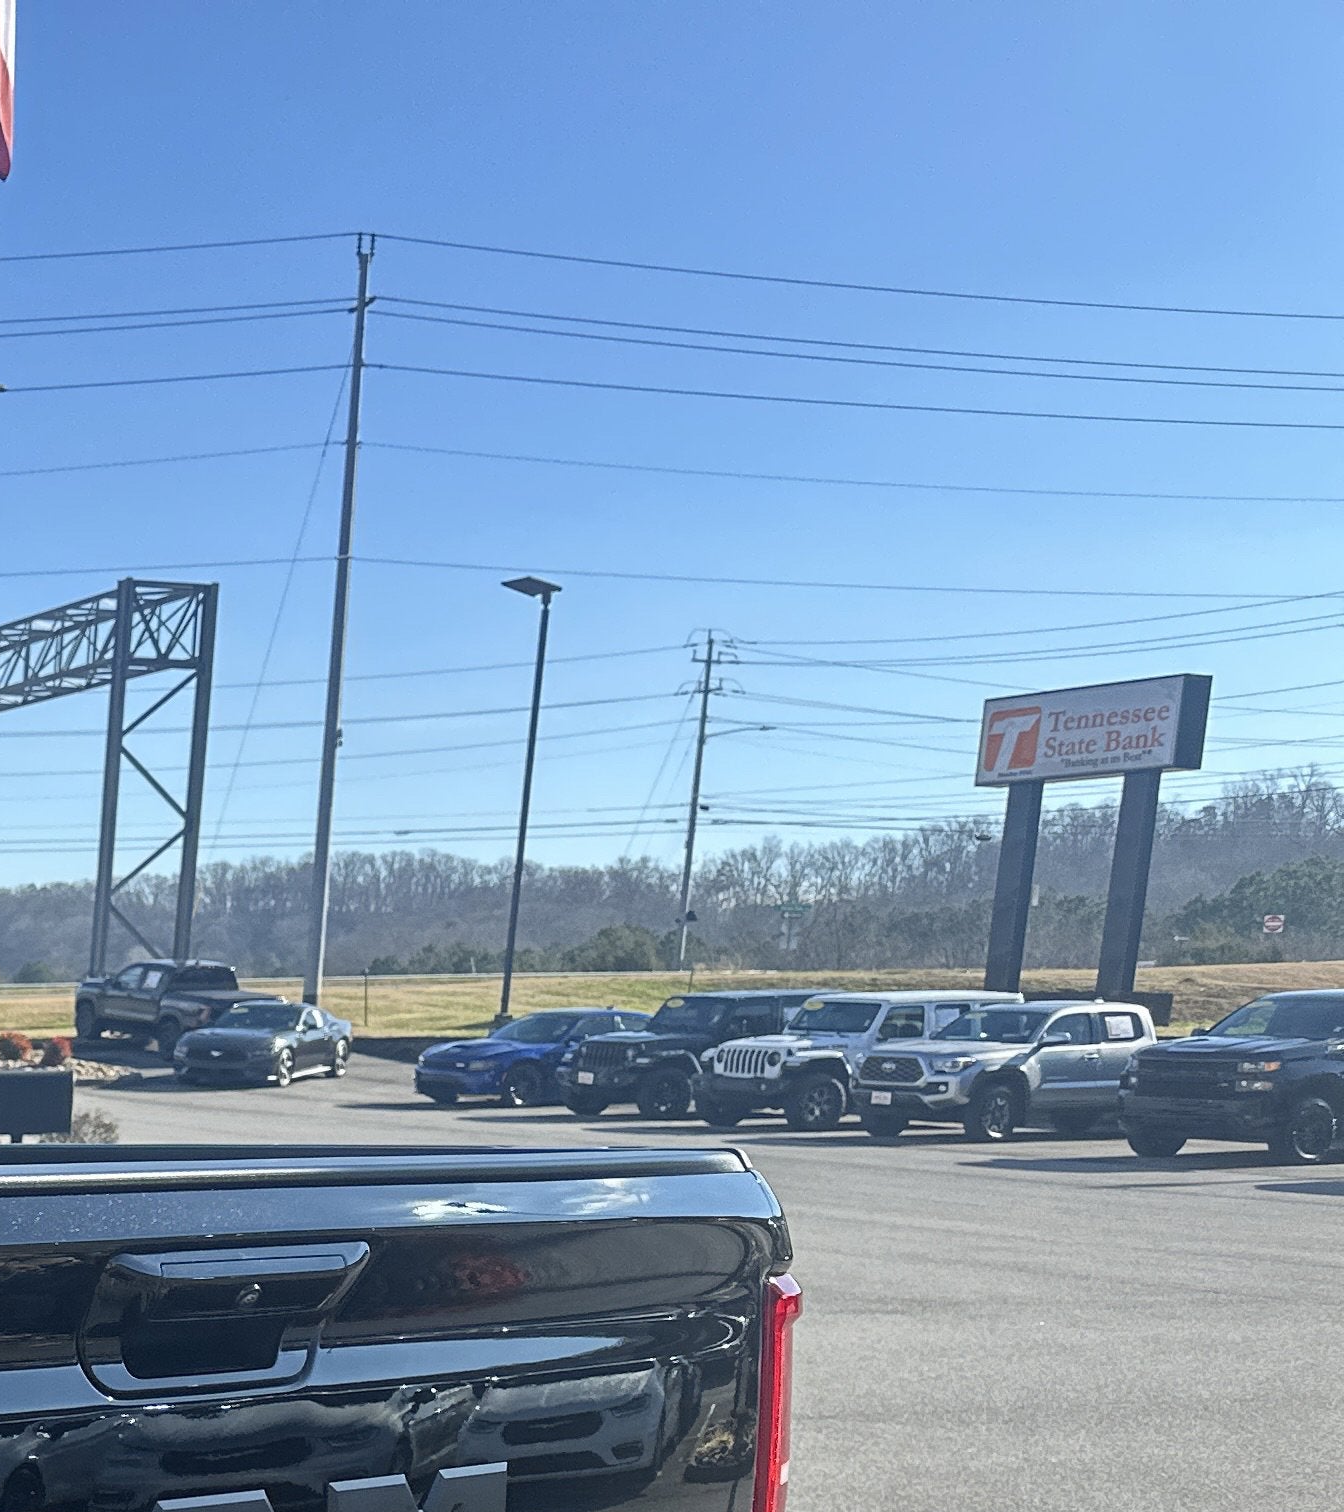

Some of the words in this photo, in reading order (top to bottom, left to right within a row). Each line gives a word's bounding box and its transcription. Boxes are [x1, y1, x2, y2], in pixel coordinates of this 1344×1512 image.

[1048, 704, 1170, 732] Tennessee
[1044, 736, 1097, 758] State
[1103, 725, 1165, 752] Bank
